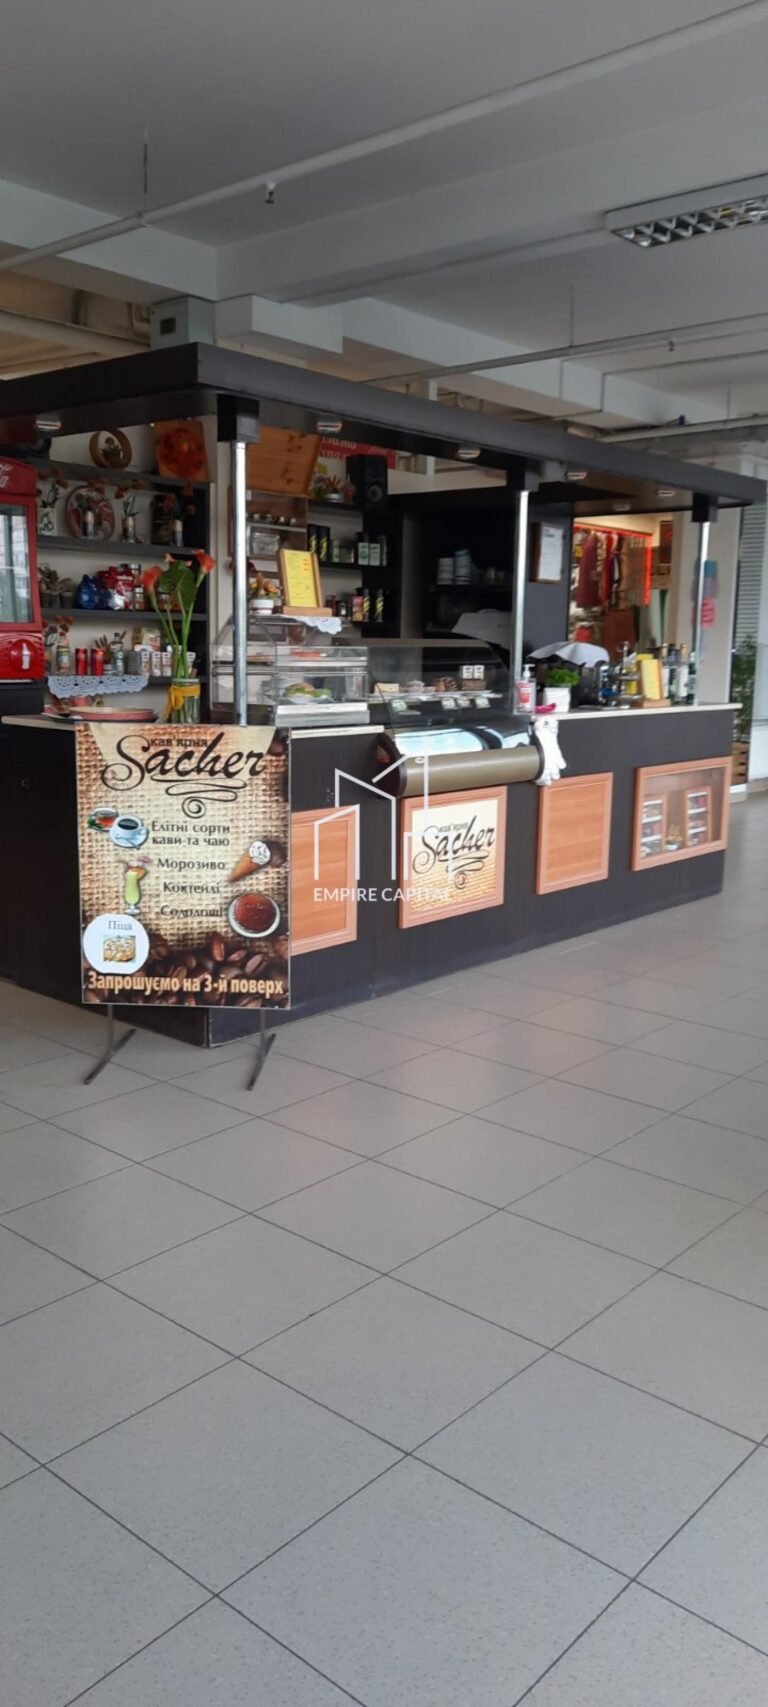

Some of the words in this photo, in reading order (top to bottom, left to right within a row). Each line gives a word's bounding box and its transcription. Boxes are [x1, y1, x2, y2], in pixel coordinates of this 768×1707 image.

[101, 732, 265, 791] Sacher
[152, 821, 188, 832] Елітні
[192, 824, 230, 836] сорти
[152, 837, 182, 845] кави
[187, 837, 199, 846] та
[203, 837, 230, 847] чаю
[412, 815, 495, 874] Sacher
[157, 858, 225, 872] Морозиво
[163, 881, 221, 894] Коктейлі
[108, 920, 130, 930] Піца
[87, 971, 180, 995] Запрошуємо
[183, 976, 200, 992] на
[203, 975, 227, 993] 3-й
[230, 978, 284, 998] поверх
